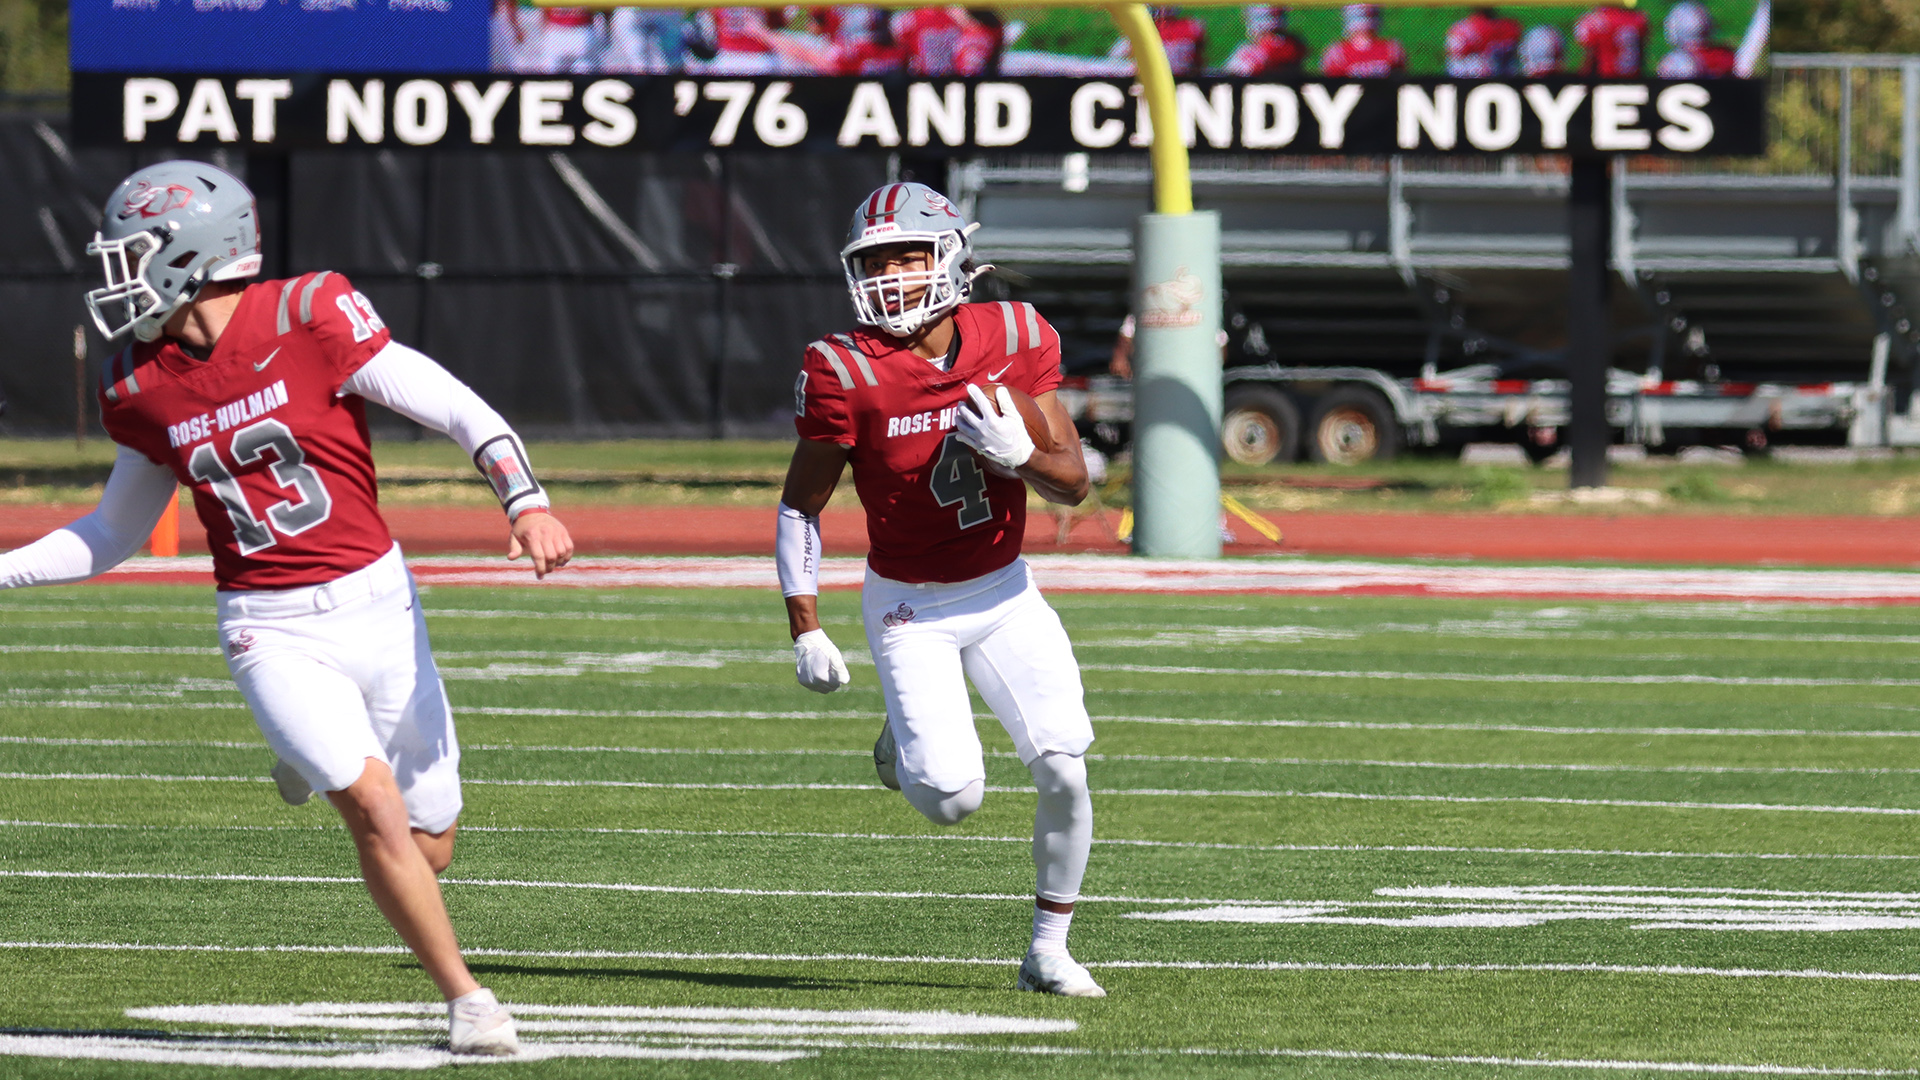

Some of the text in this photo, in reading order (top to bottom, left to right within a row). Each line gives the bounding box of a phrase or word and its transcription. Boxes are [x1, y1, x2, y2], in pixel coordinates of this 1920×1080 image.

[122, 77, 1716, 152] PAT NOYES '76 AND CINDY NOYES
[336, 290, 387, 344] 13
[167, 379, 289, 449] ROSE-HULMAN
[794, 370, 808, 418] 4
[188, 417, 333, 557] 13
[930, 431, 993, 530] 4
